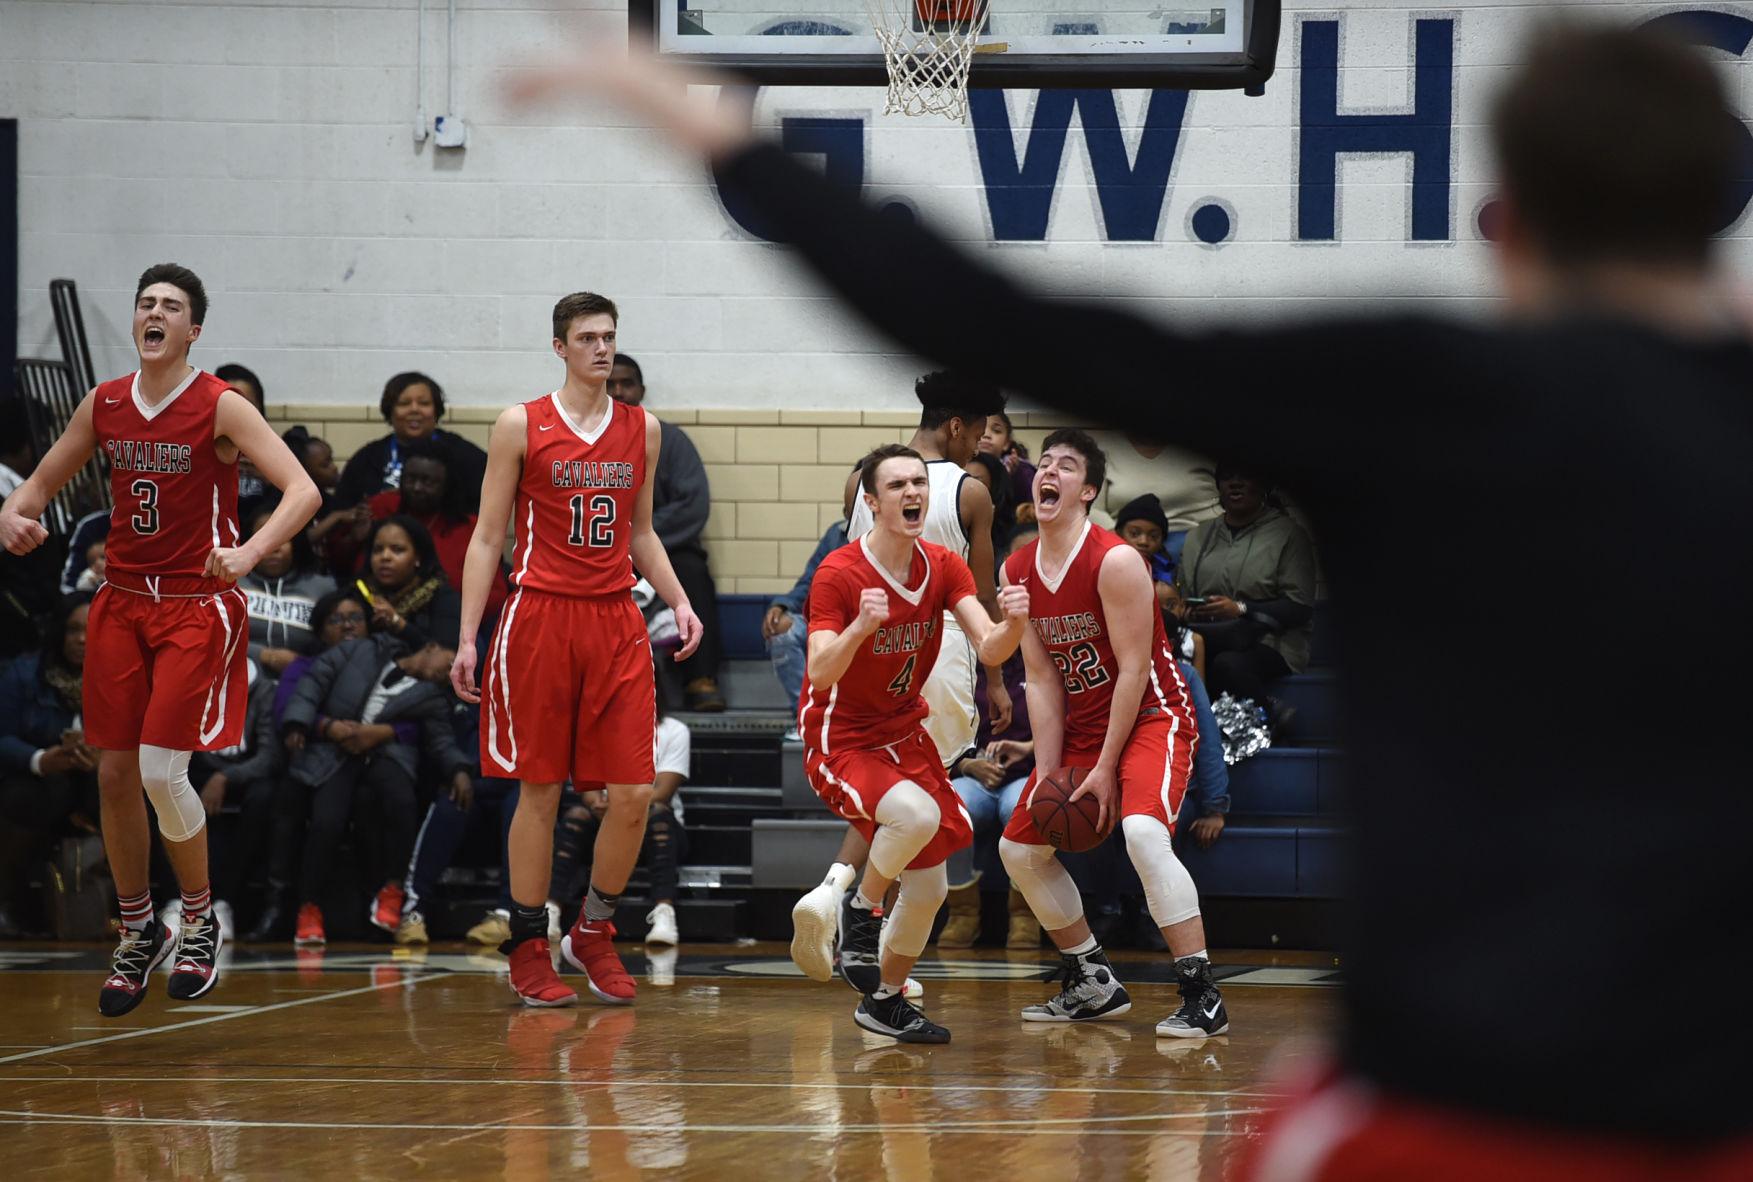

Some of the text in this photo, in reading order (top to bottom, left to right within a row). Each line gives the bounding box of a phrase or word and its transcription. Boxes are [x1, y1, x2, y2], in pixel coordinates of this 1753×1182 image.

[551, 460, 633, 490] CAVALIERS
[131, 479, 160, 535] 3
[567, 493, 617, 548] 12
[886, 653, 917, 698] 4
[1049, 642, 1111, 694] 22
